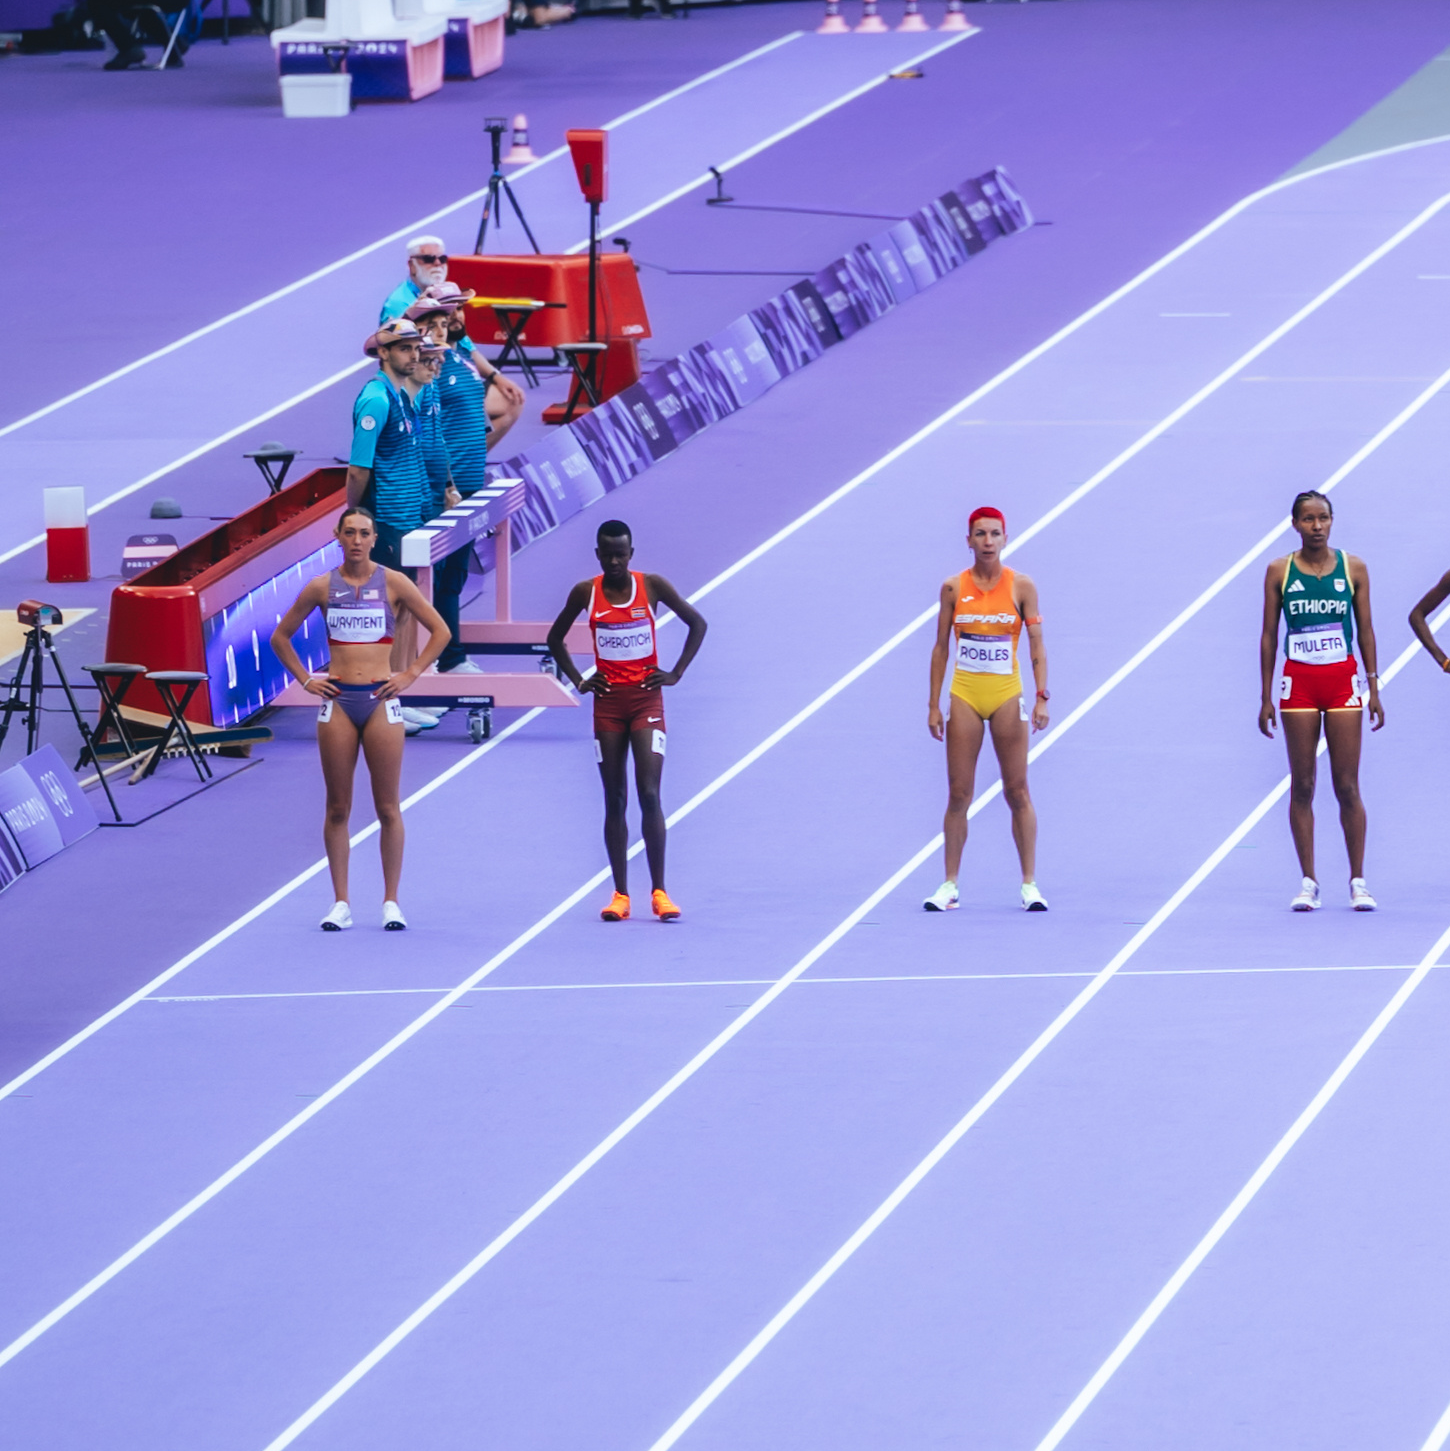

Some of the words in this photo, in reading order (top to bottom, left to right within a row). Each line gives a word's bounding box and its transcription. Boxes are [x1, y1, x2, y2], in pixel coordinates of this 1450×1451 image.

[1289, 598, 1349, 616] ETHIOPIA
[329, 615, 384, 630] WAYMENT
[954, 613, 1017, 625] ESPAÑA
[598, 631, 651, 649] CHEROTICH
[1294, 637, 1343, 654] MULETA
[960, 645, 1010, 662] ROBLES
